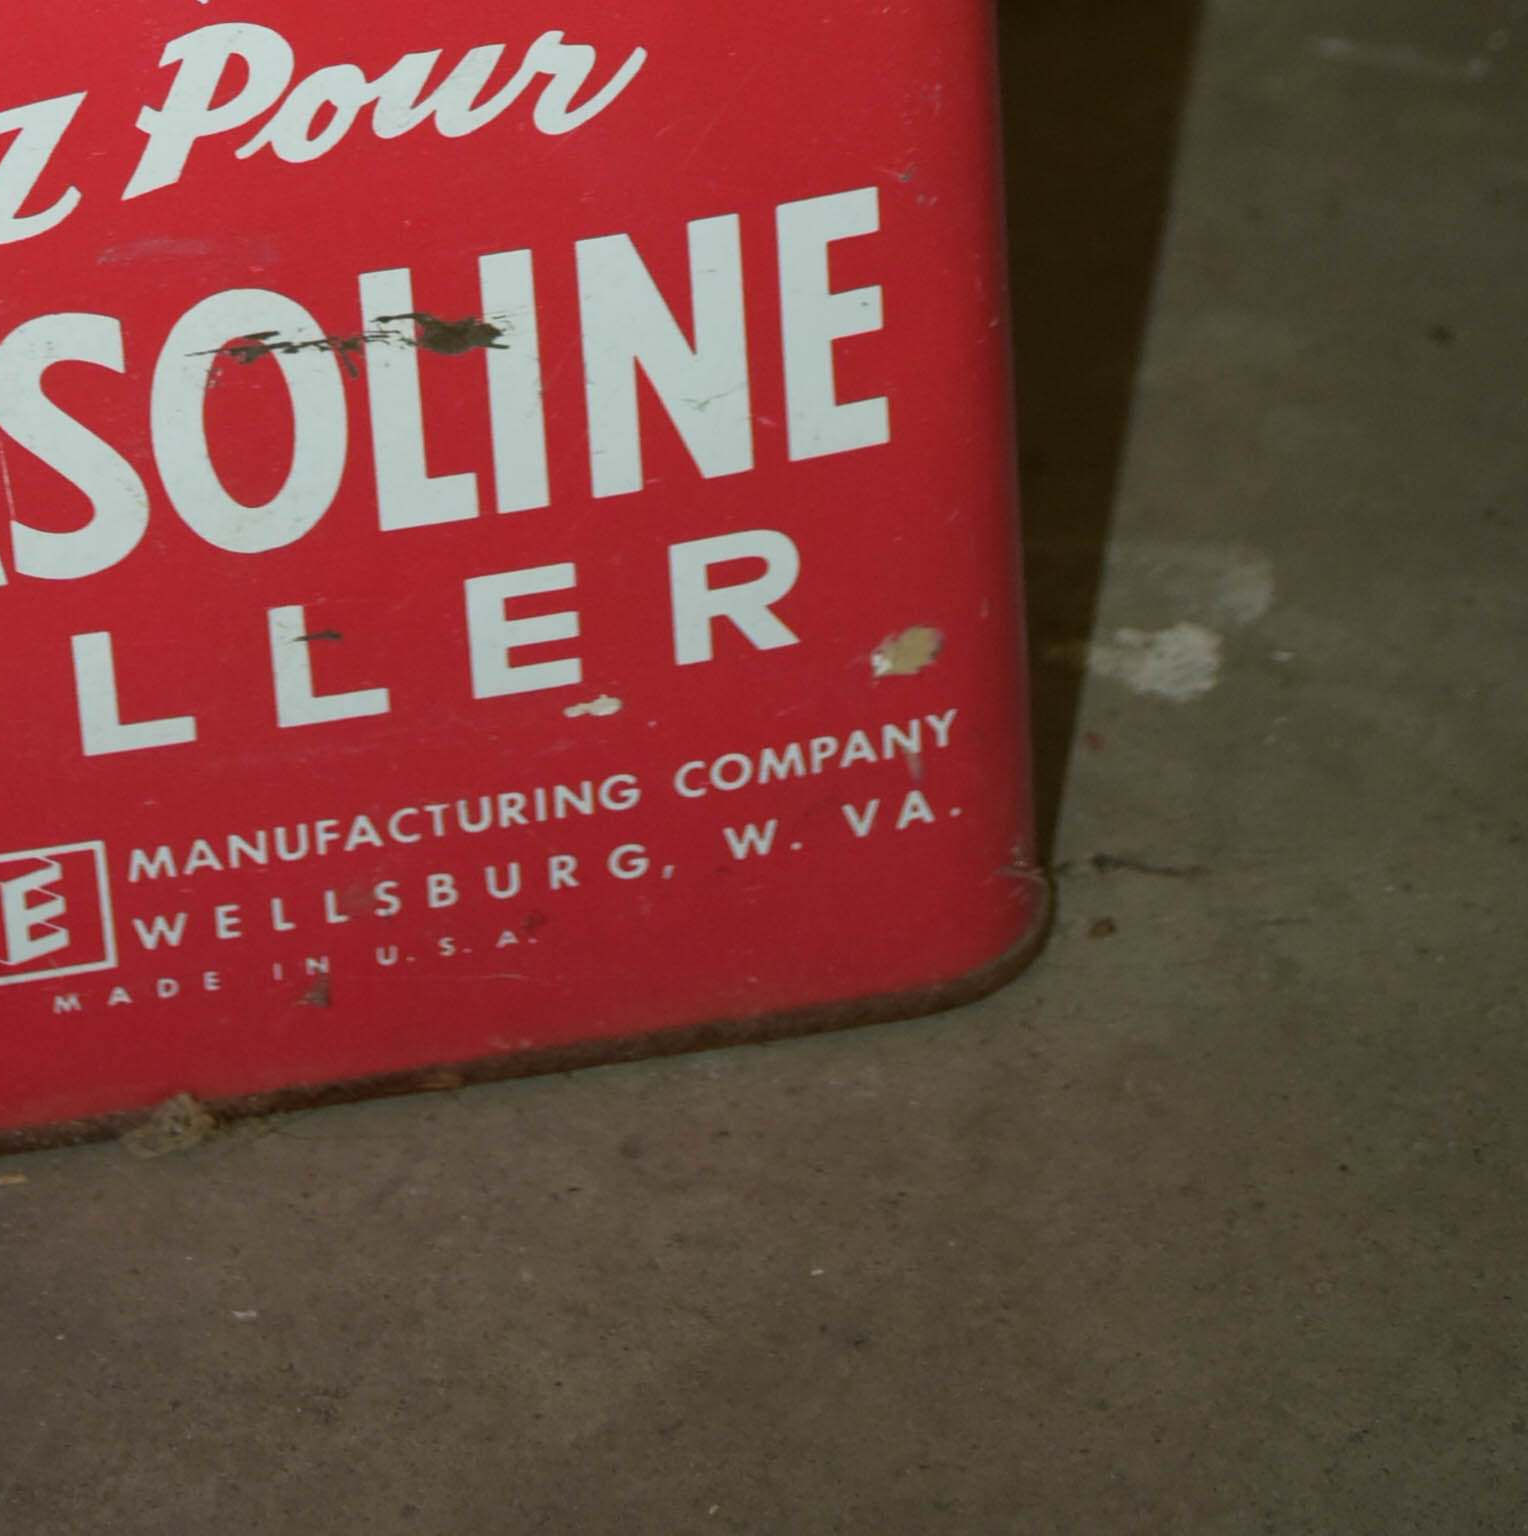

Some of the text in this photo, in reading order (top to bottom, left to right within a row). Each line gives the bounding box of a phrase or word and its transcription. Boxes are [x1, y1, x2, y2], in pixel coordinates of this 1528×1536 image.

[121, 22, 647, 200] Pour
[127, 708, 959, 883] MANUFACTURING COMPANY
[132, 789, 963, 951] WELLSBURG, W. VA.
[52, 970, 221, 1015] MADE
[273, 955, 331, 981] IN
